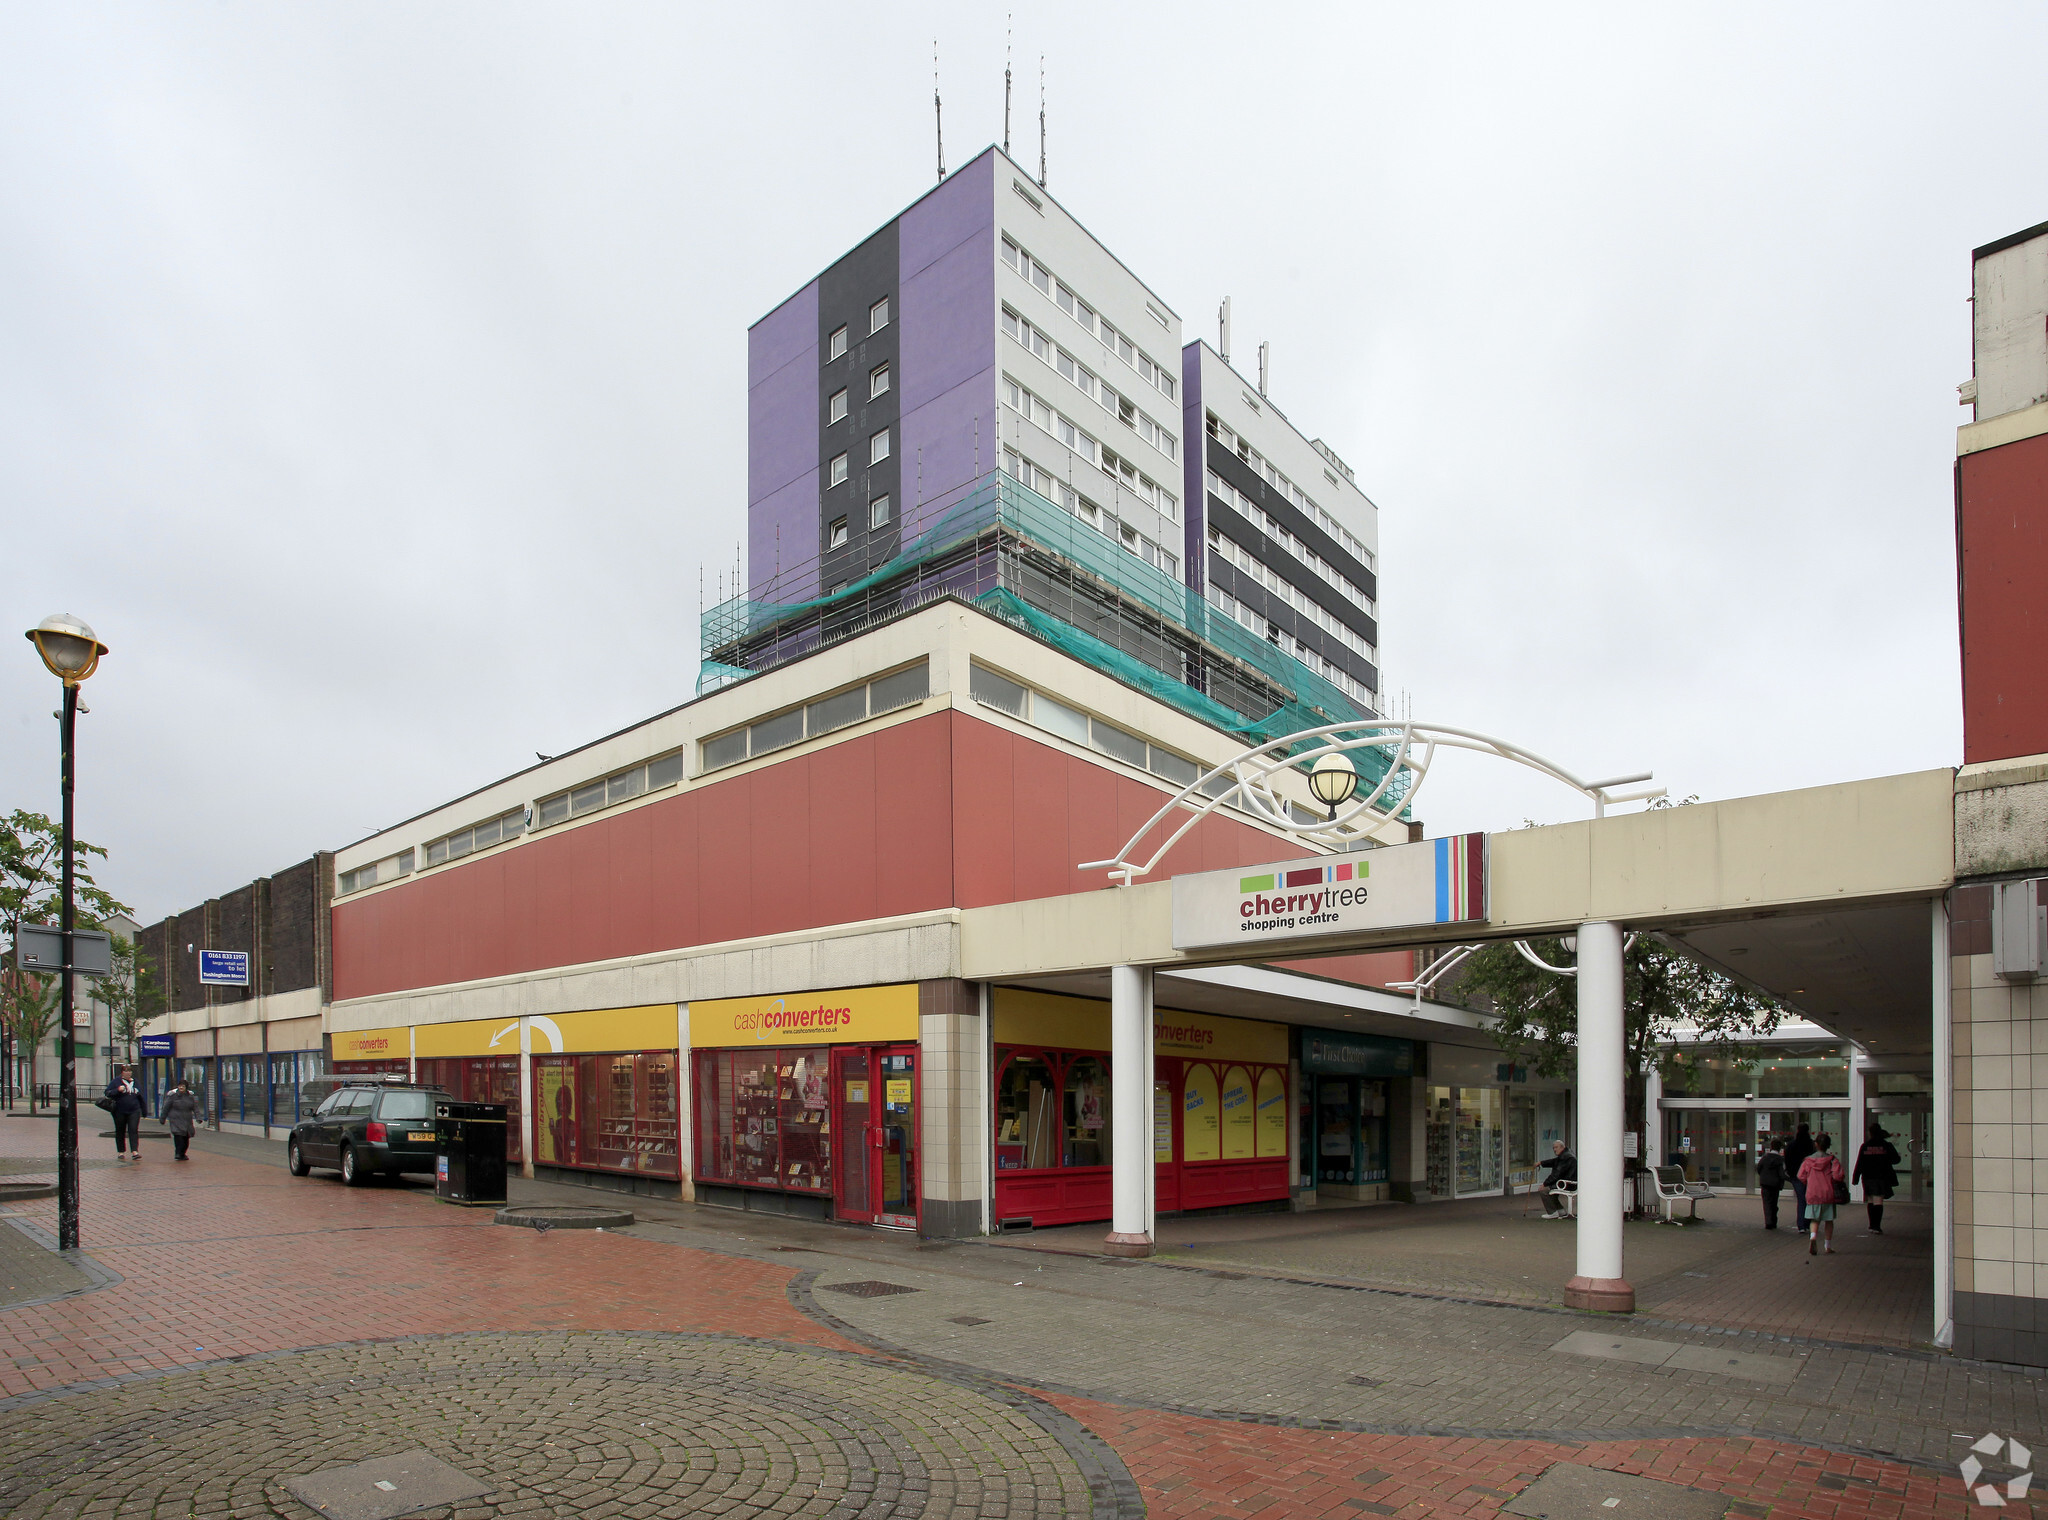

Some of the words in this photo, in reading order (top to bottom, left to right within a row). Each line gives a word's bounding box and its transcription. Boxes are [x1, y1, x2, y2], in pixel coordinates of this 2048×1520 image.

[1240, 886, 1368, 918] cherrytree
[1241, 917, 1295, 932] shopping
[1299, 912, 1339, 925] centre
[734, 1005, 851, 1030] cashconverters
[1323, 1044, 1340, 1062] First
[1341, 1046, 1367, 1064] Choice
[1185, 1089, 1197, 1101] BUY
[1223, 1086, 1243, 1102] SPREAD
[1223, 1100, 1234, 1111] THE
[1235, 1094, 1248, 1106] COST
[1186, 1097, 1204, 1112] BACKS
